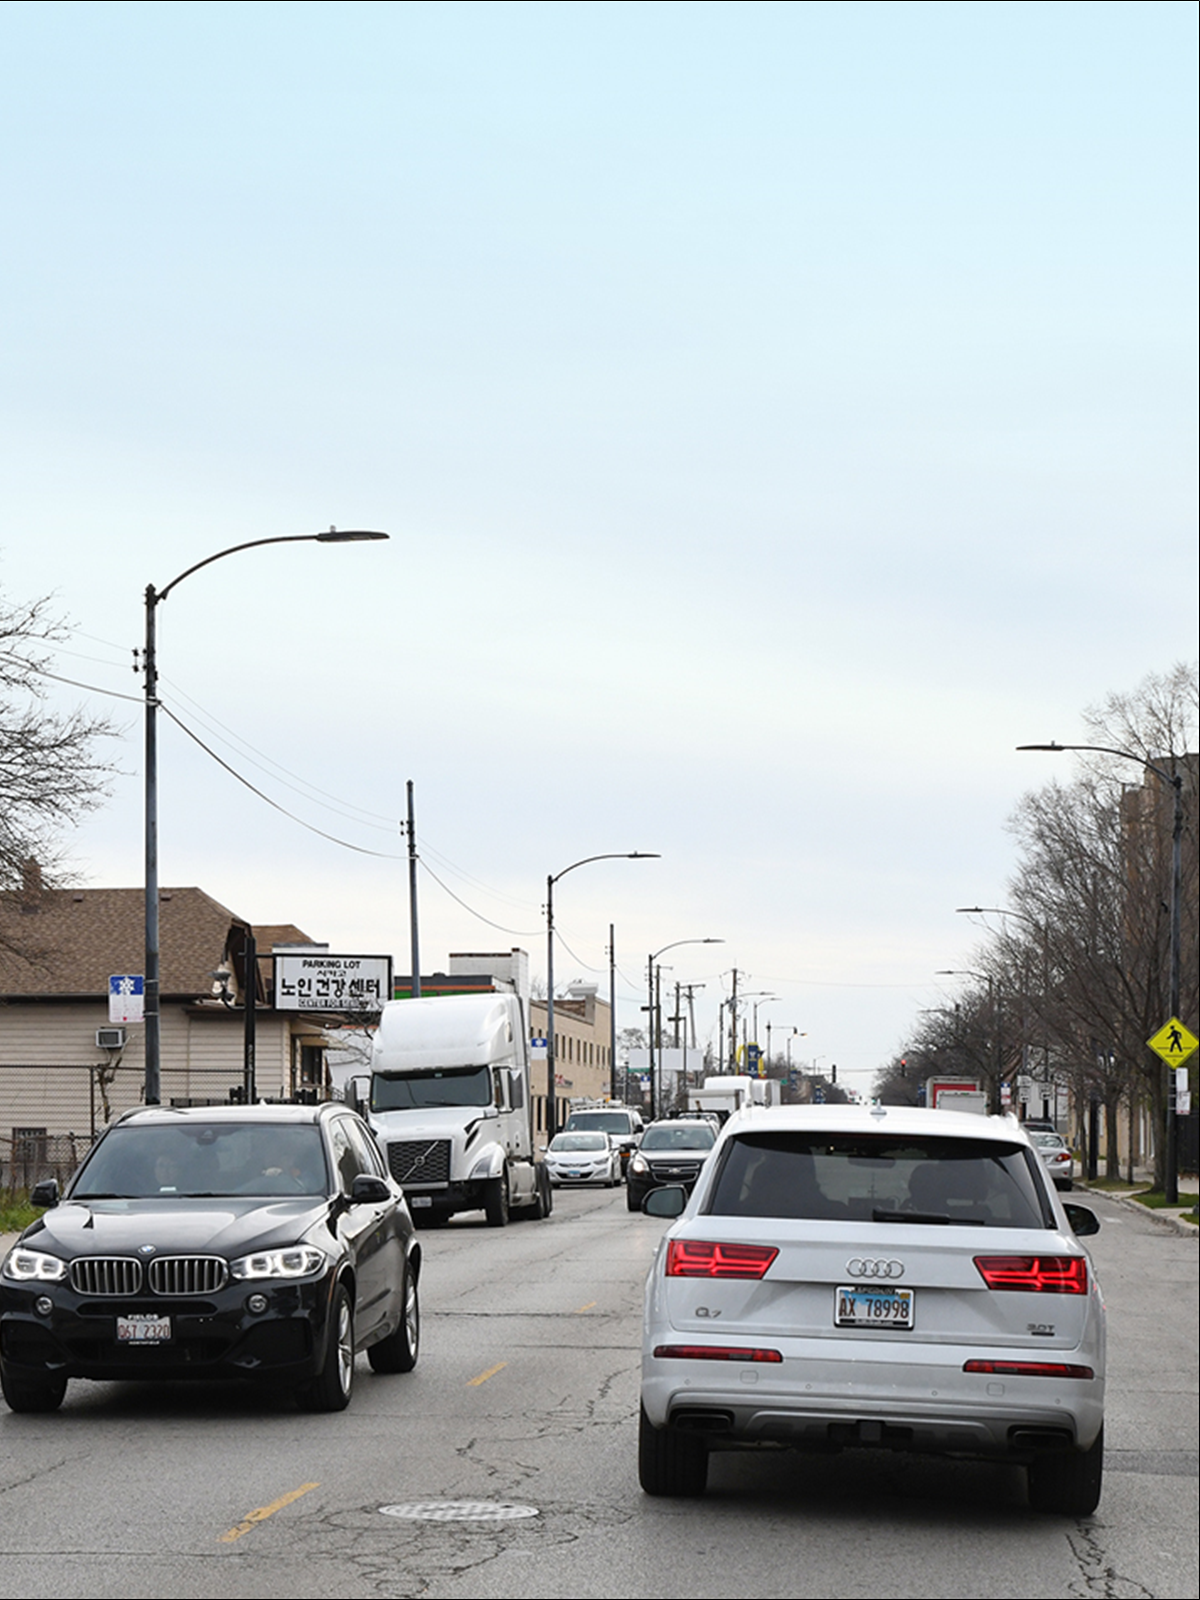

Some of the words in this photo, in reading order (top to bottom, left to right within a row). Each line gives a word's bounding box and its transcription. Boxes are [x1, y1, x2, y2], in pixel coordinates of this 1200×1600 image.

[302, 960, 341, 969] PARKING
[343, 960, 361, 969] LOT
[839, 1297, 856, 1317] AX
[865, 1299, 909, 1319] 78998
